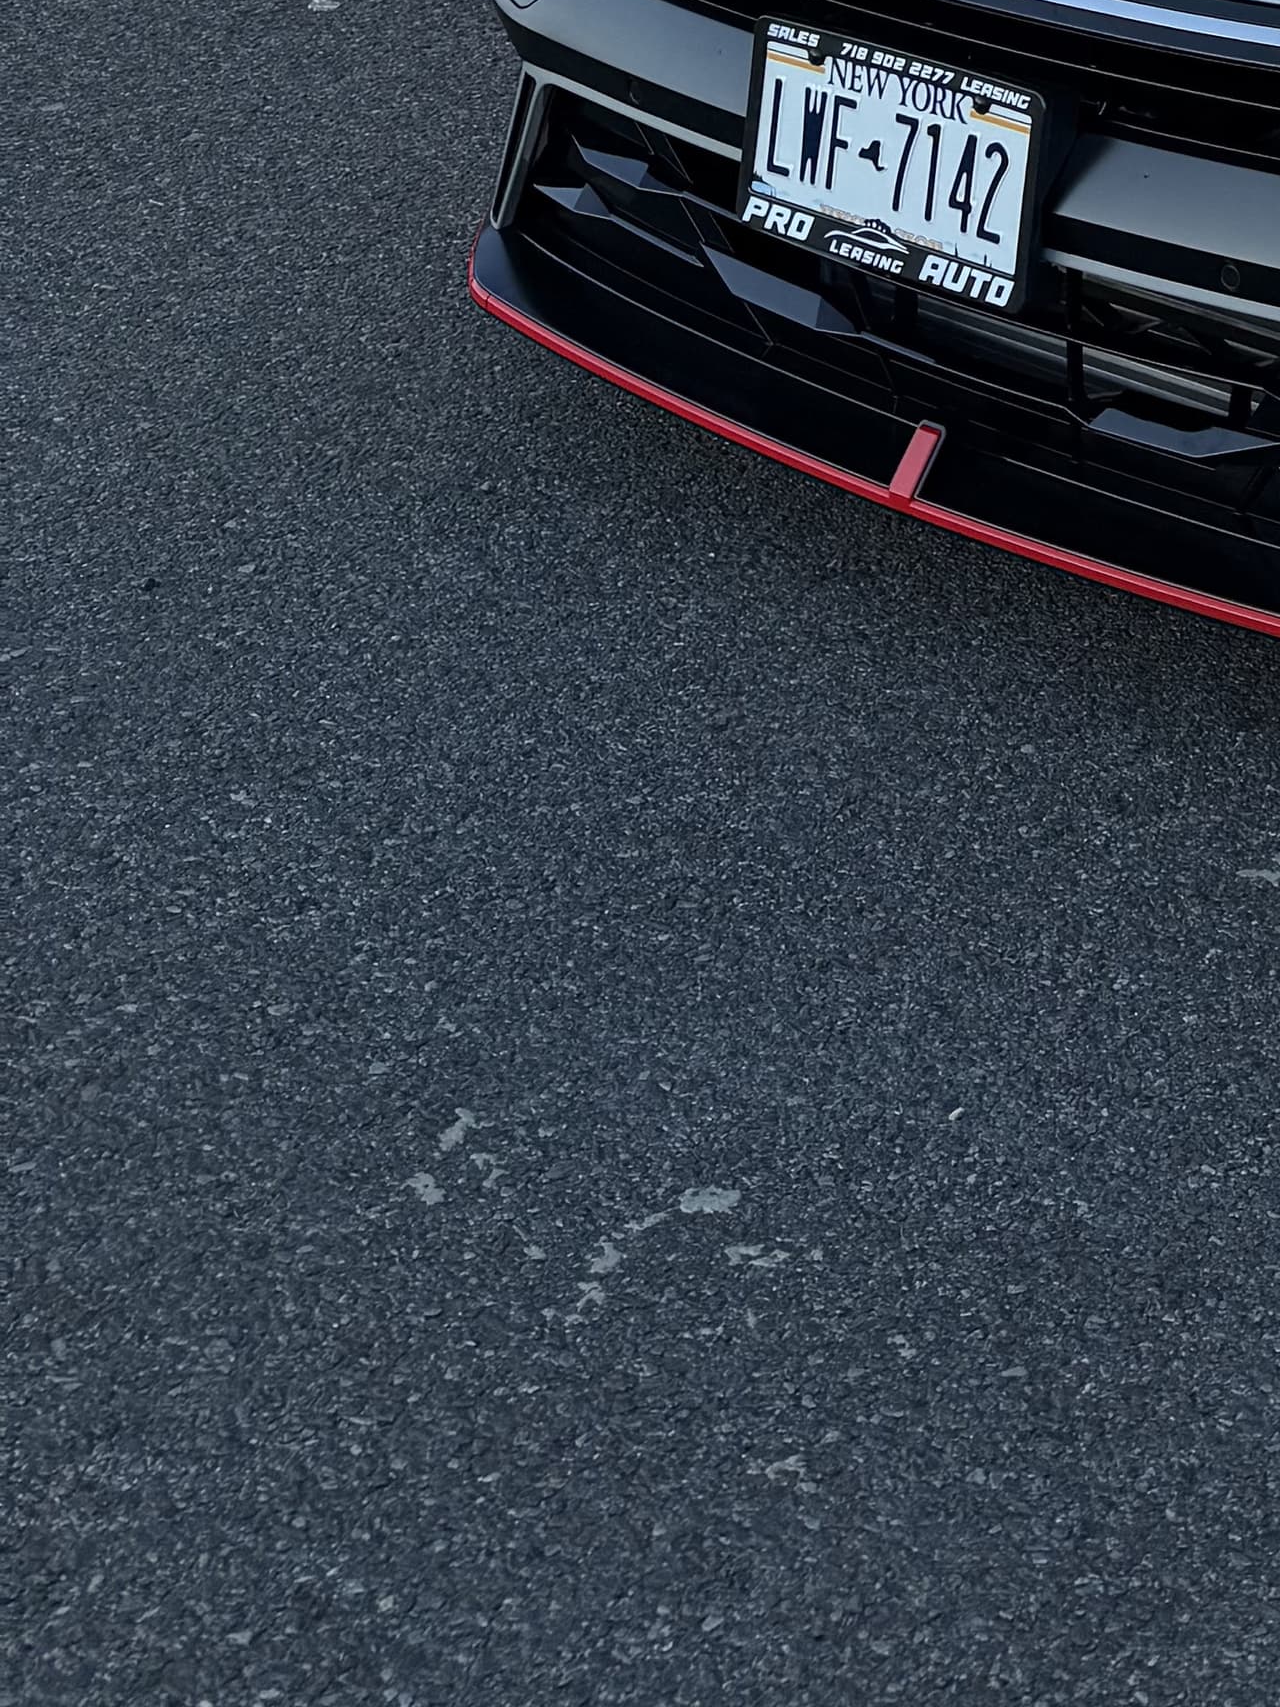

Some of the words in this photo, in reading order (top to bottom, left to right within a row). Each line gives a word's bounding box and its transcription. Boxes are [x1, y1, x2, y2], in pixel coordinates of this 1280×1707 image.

[767, 23, 820, 48] SALES
[839, 42, 868, 62] 718
[871, 51, 906, 71] 902
[908, 62, 956, 85] 2277
[828, 58, 892, 100] NEW
[890, 74, 968, 124] YORK
[959, 75, 1031, 110] LEASING
[766, 77, 858, 191] LWF
[891, 112, 1010, 245] 7142
[741, 196, 816, 241] PRO
[829, 238, 905, 274] LEASING
[918, 253, 1015, 308] AUTO
